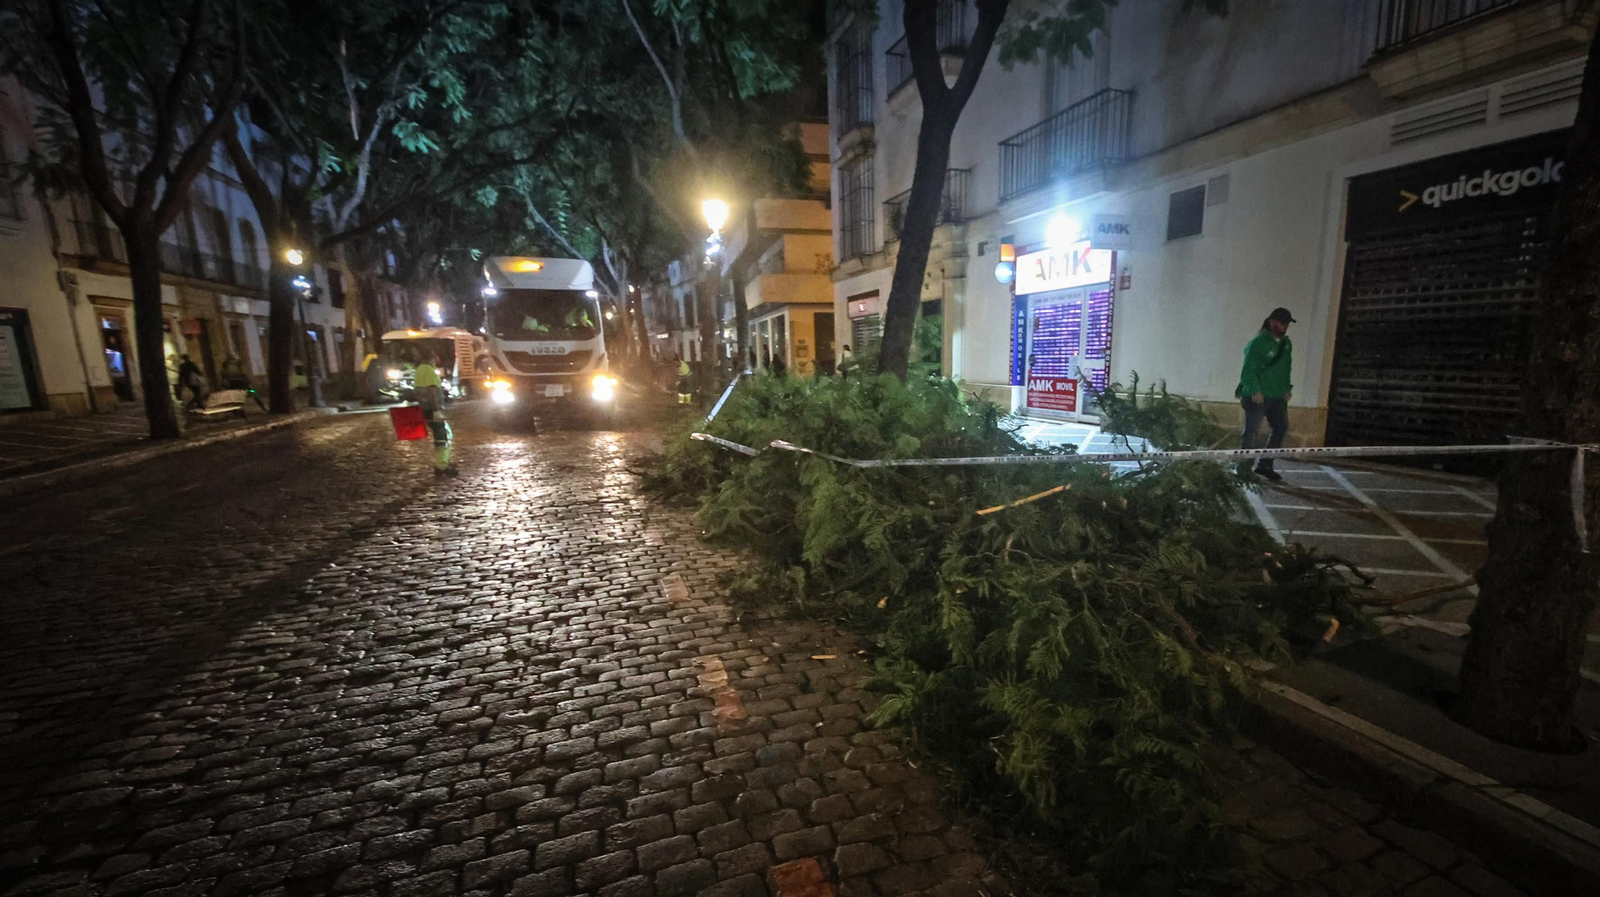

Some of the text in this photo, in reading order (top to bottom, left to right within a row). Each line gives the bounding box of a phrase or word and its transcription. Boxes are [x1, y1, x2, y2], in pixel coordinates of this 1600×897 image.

[1097, 223, 1130, 235] AMK
[1034, 246, 1092, 281] AMK
[1028, 379, 1075, 392] AMK MOVIL
